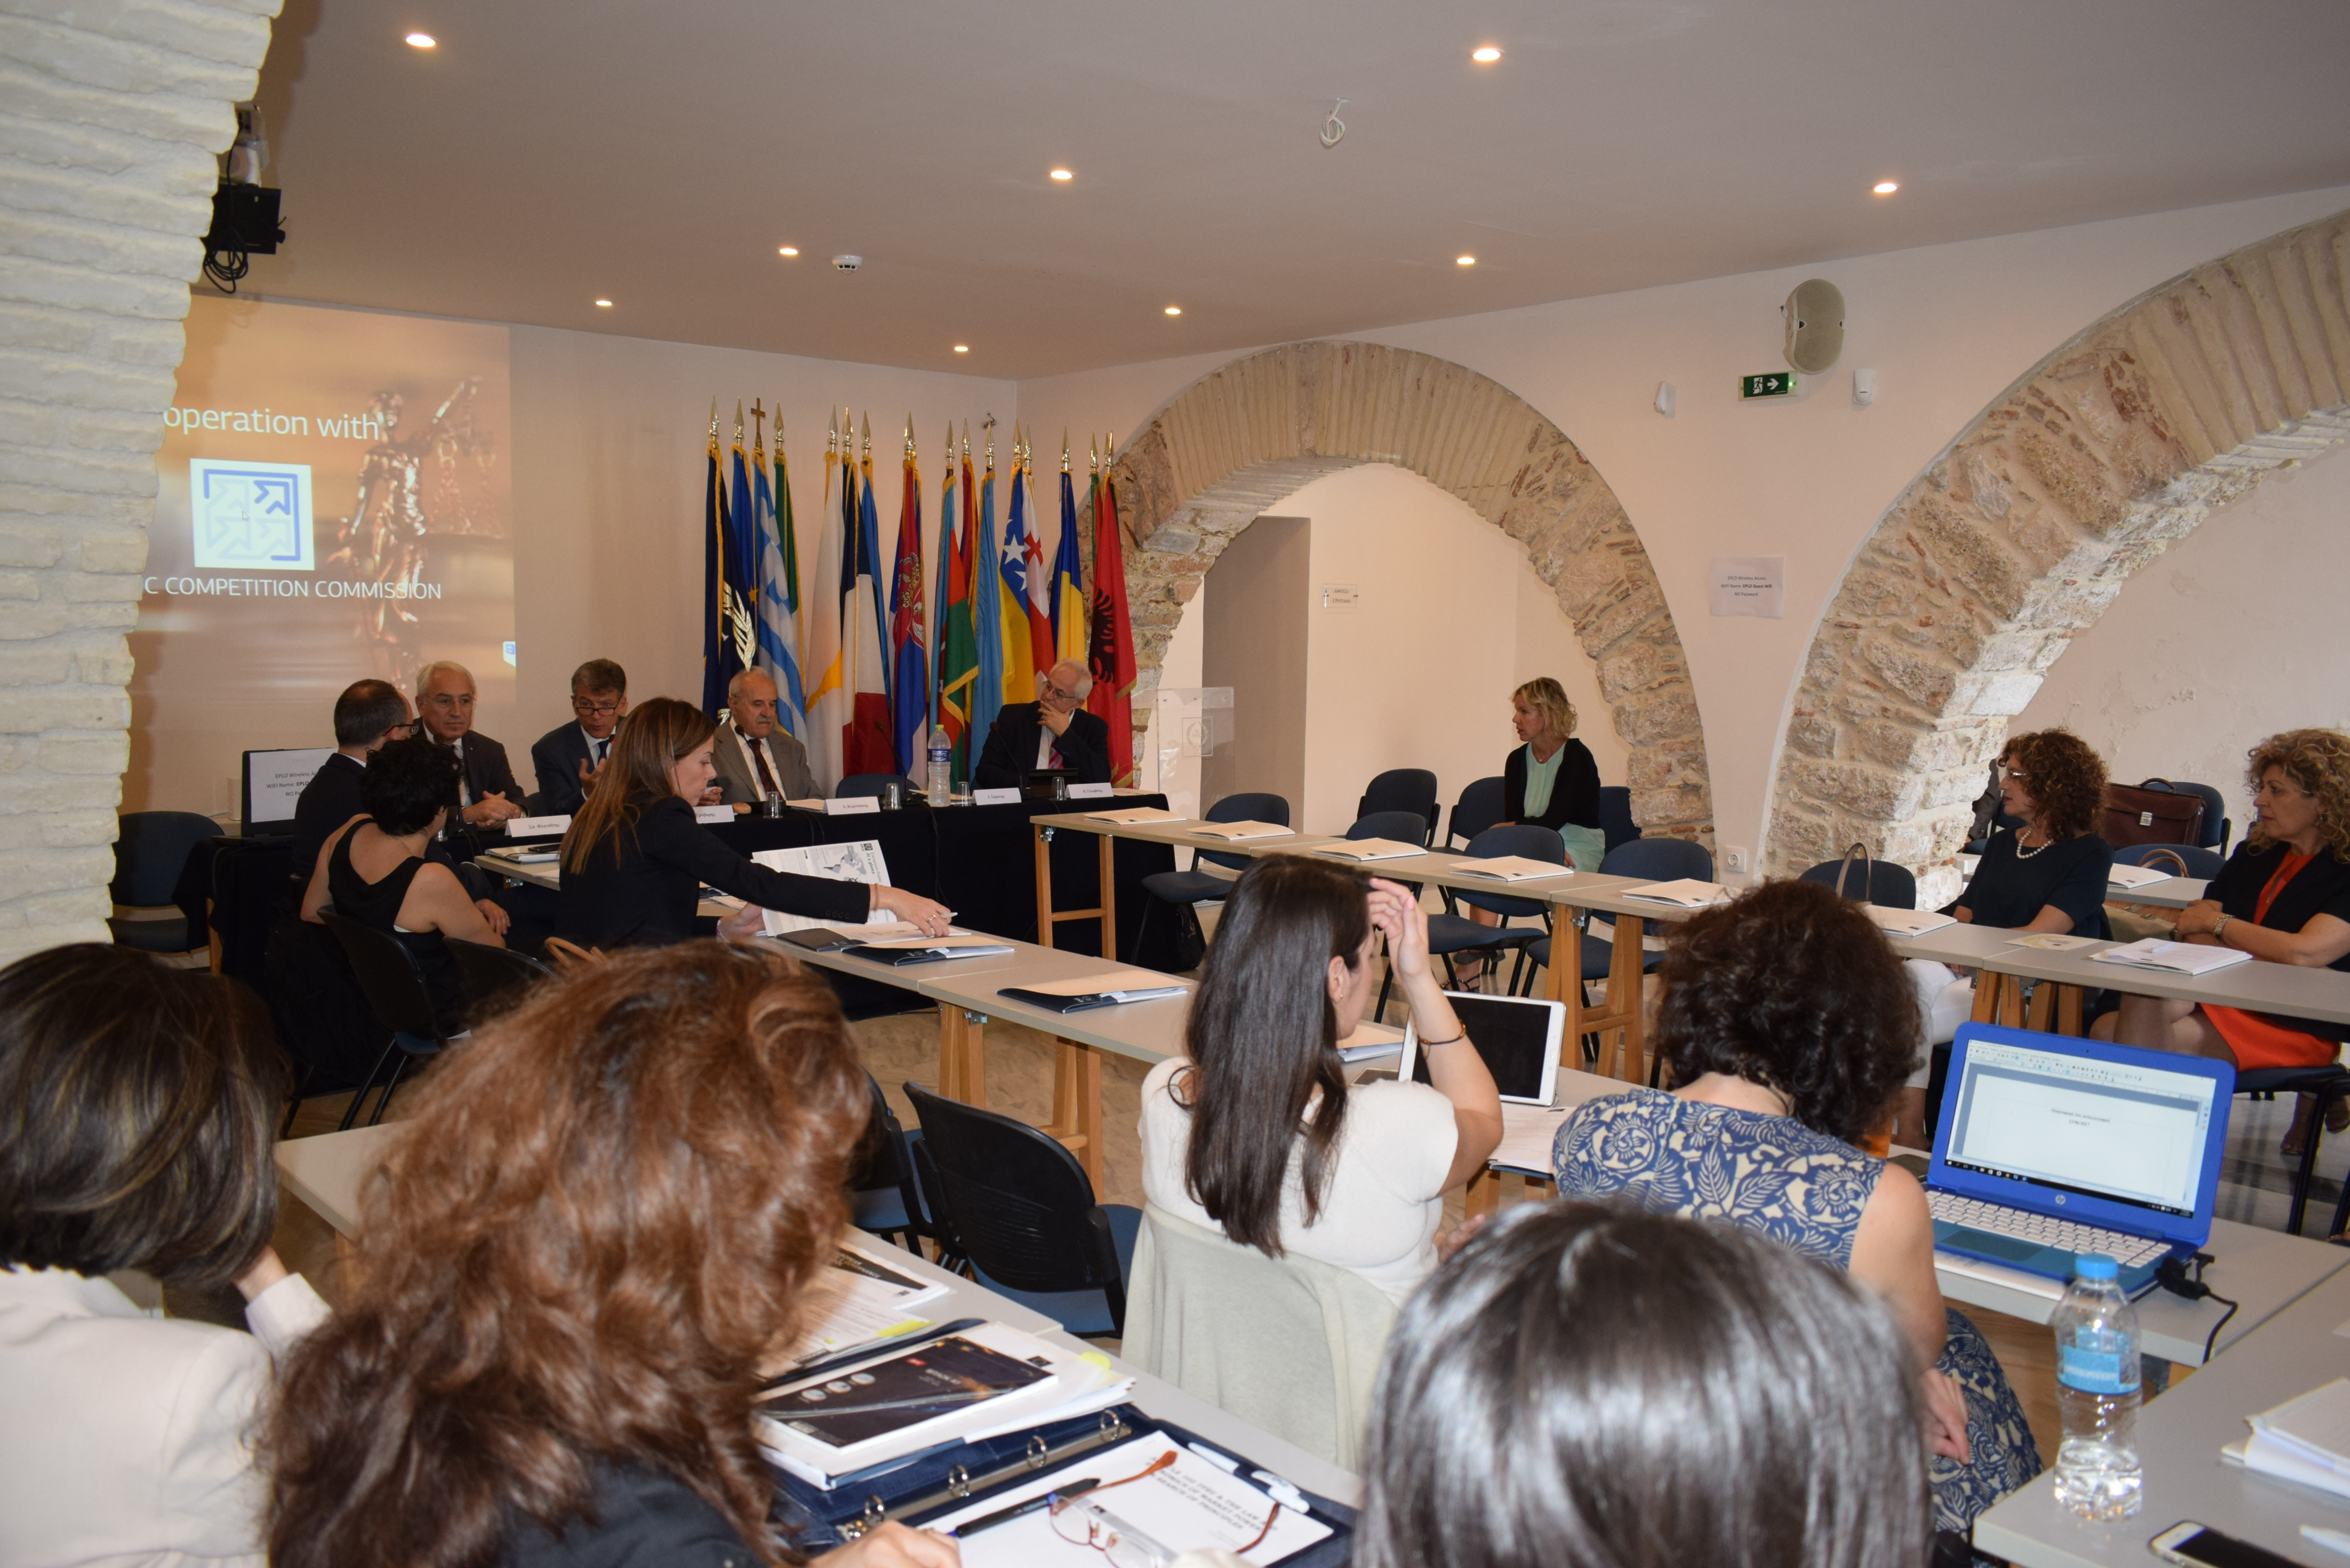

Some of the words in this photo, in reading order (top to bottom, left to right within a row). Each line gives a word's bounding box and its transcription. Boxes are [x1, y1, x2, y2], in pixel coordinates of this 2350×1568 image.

[317, 414, 379, 440] with
[165, 577, 308, 597] COMPETITION
[315, 580, 442, 599] COMMISSION
[870, 852, 879, 871] European
